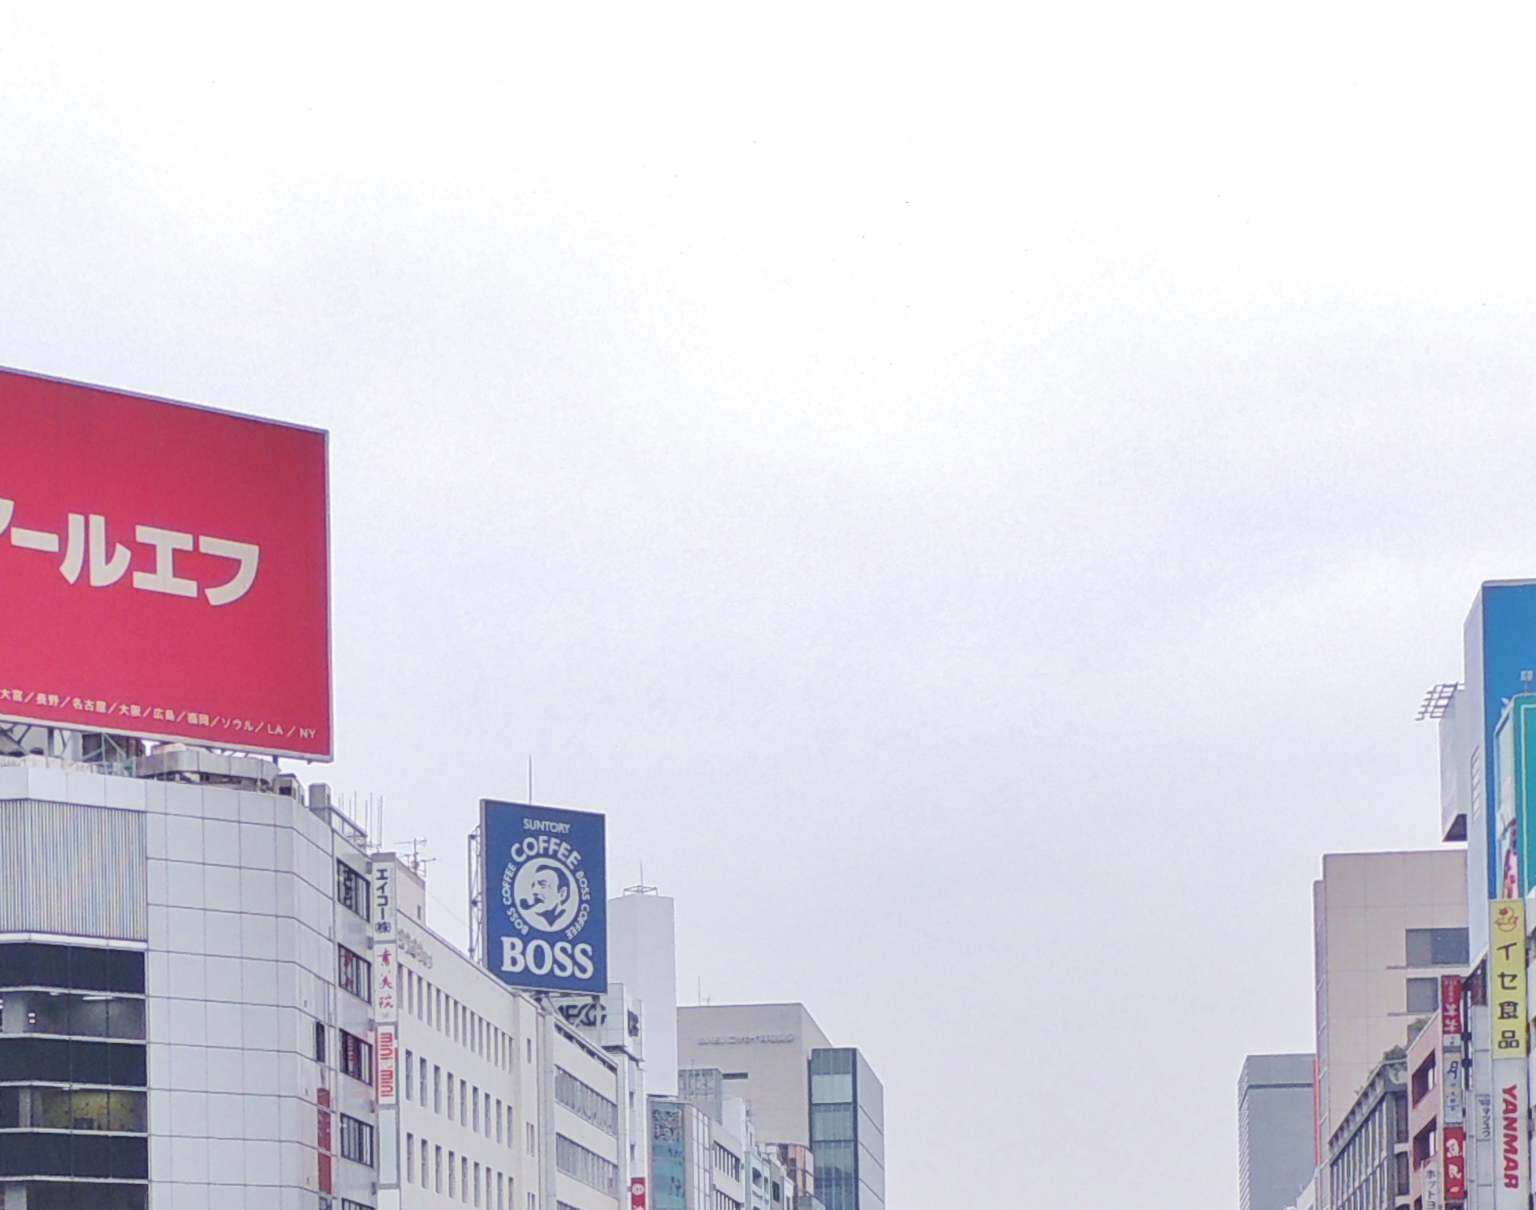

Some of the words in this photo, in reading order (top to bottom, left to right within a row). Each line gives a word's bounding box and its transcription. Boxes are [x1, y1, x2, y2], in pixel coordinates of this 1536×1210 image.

[523, 818, 571, 834] SUNTORY
[511, 835, 581, 870] COFFEE
[501, 863, 517, 906] COFFEE
[500, 936, 595, 980] BOSS
[1495, 941, 1519, 1050] イセ食品
[1501, 1083, 1520, 1190] YANMAR
